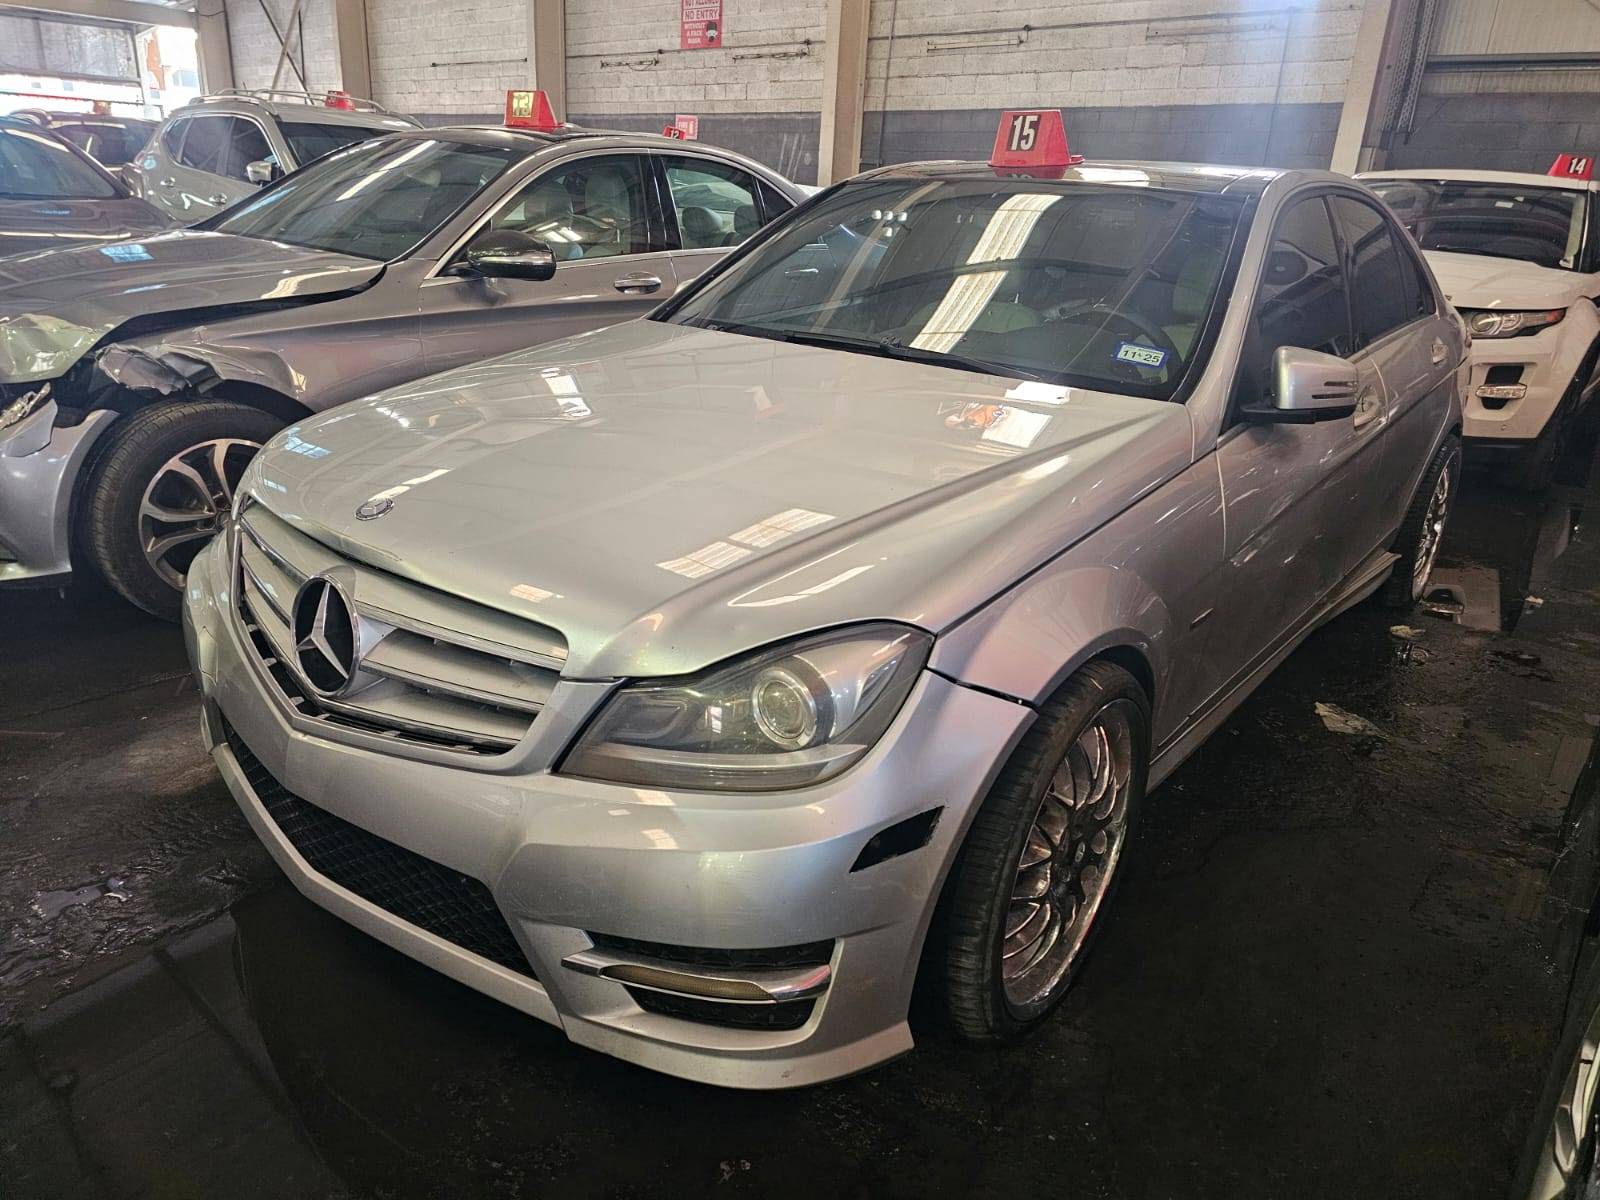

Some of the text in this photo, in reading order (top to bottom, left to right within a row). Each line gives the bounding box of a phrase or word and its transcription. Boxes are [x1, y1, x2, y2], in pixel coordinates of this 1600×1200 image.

[684, 9, 718, 20] NO ENTRY
[670, 129, 680, 140] 12
[1011, 115, 1039, 151] 15
[1569, 157, 1587, 175] 14
